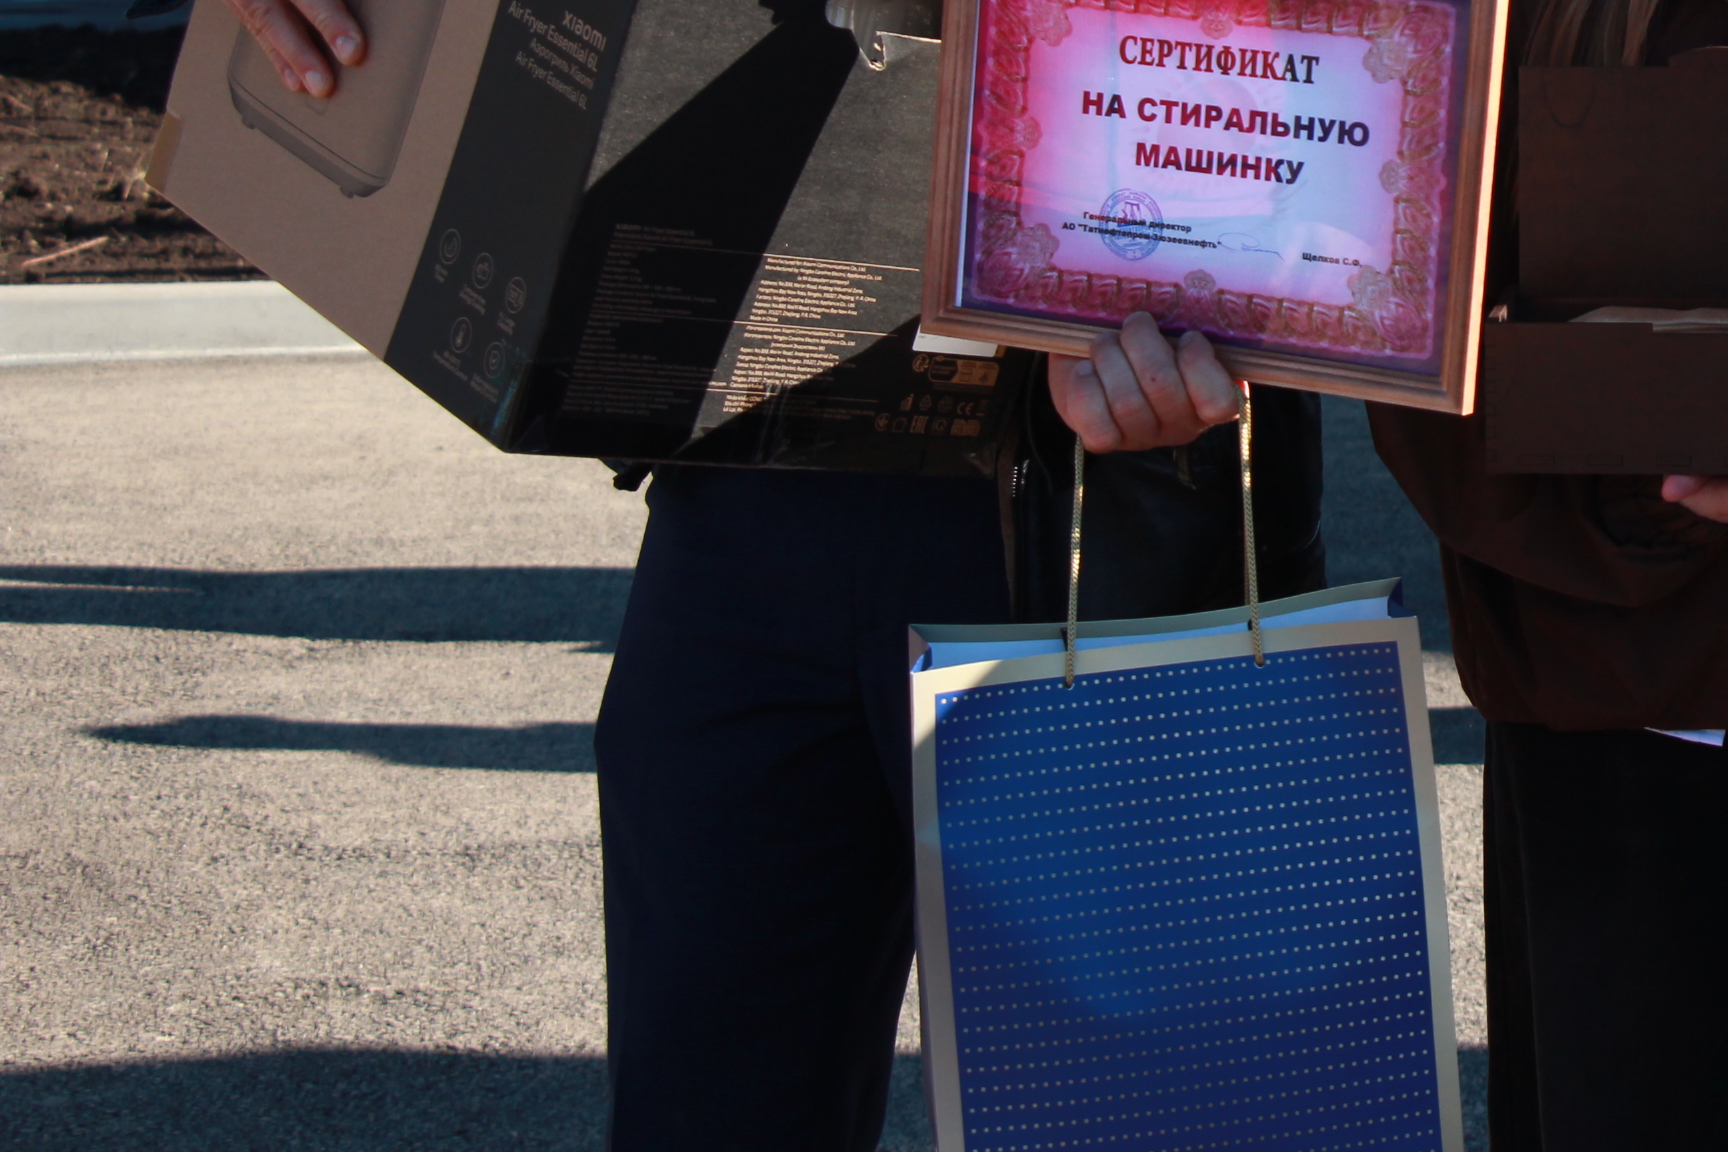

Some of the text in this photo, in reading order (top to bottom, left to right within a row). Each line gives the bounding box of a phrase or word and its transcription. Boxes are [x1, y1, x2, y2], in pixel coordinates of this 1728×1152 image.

[508, 0, 598, 72] Air Fryer Essential 6L
[516, 51, 527, 67] Air
[1119, 35, 1320, 84] СЕРТИФИКАТ
[1082, 90, 1370, 147] НА СТИРАЛЬНУЮ
[1135, 142, 1305, 185] МАШИНКУ
[1061, 222, 1076, 231] АО
[1083, 211, 1192, 234] Генеральный директор
